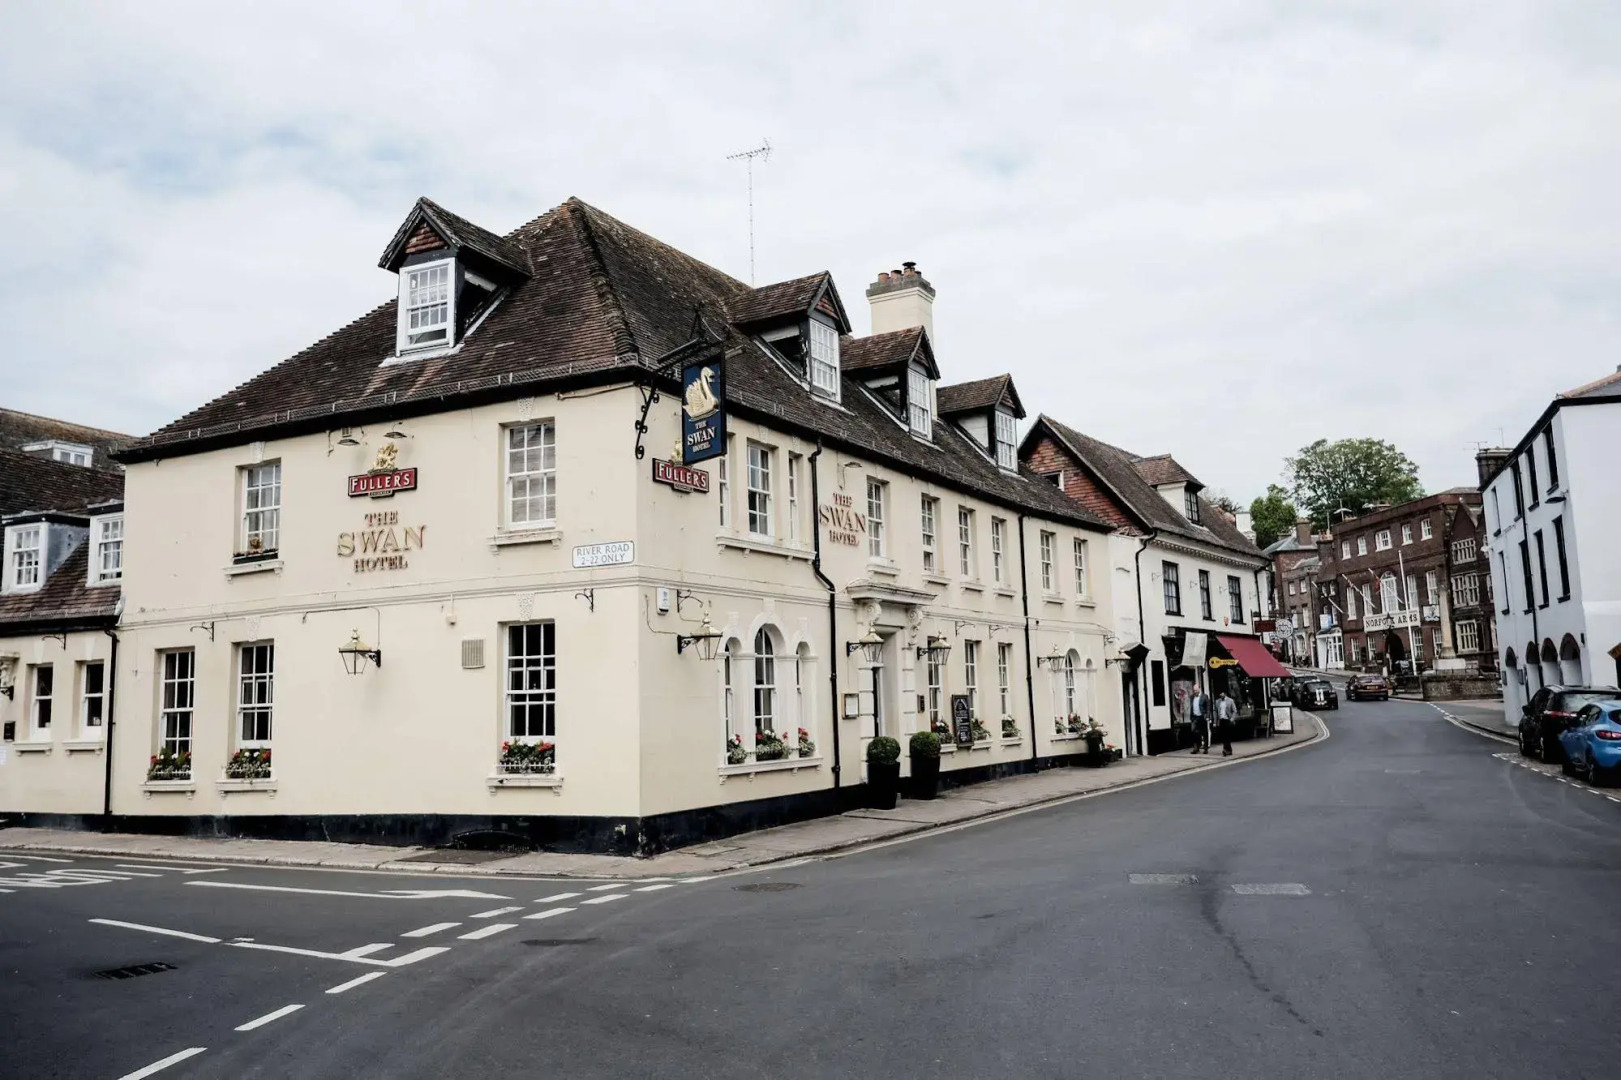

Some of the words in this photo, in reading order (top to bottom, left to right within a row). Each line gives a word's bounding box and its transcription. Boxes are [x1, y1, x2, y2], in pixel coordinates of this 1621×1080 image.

[695, 420, 707, 429] THE
[687, 427, 715, 445] SWAN
[351, 473, 410, 492] FULLER'S
[659, 462, 706, 487] FULLER'S
[832, 492, 853, 507] THE
[364, 510, 399, 527] THE
[819, 504, 866, 533] SWAN
[337, 525, 426, 557] SWAN
[829, 530, 859, 546] HOTEL
[576, 546, 601, 556] RIVER
[605, 543, 630, 554] ROAD
[354, 555, 408, 573] HOTEL
[581, 555, 598, 565] 2-22
[601, 553, 625, 563] ONLY
[1365, 616, 1395, 628] NORFOK
